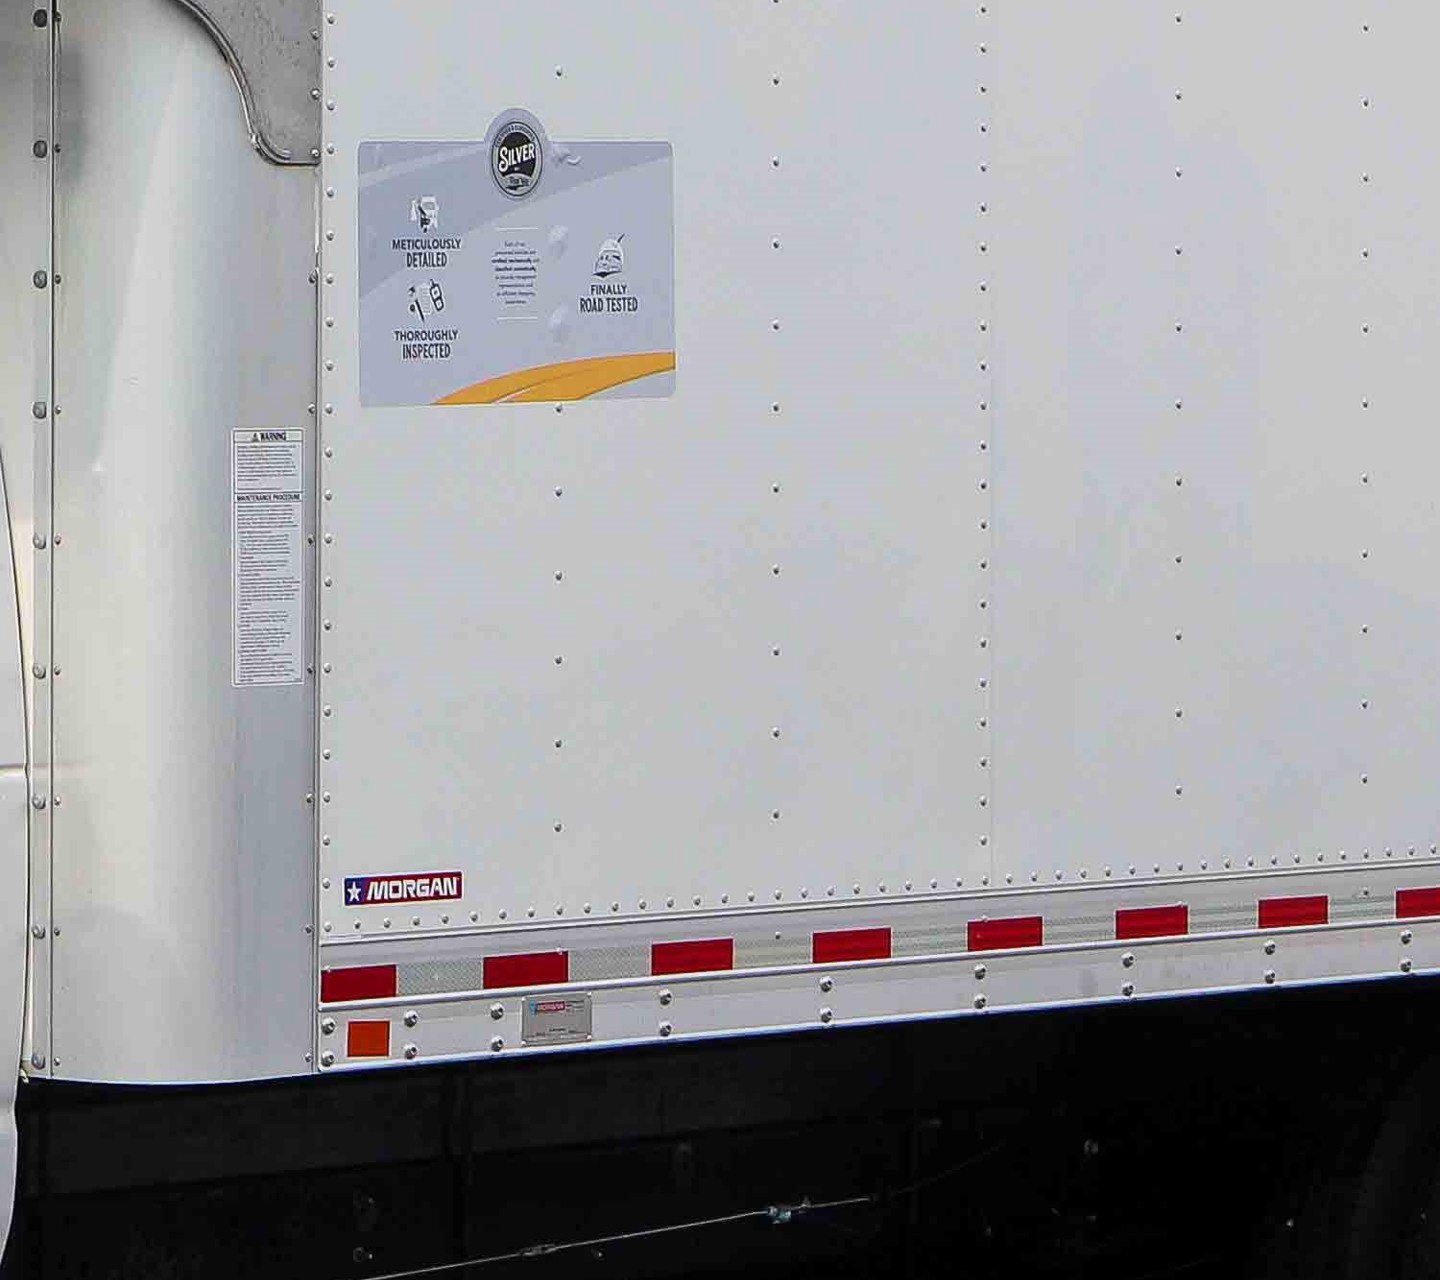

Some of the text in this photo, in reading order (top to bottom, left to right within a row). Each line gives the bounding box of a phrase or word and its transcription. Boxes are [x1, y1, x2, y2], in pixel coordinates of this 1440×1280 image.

[498, 143, 535, 172] SILVER
[392, 239, 461, 250] METICULOUSLY
[406, 252, 447, 267] DETAILED
[590, 284, 627, 295] FINALLY
[580, 297, 638, 312] ROAD TESTED
[394, 330, 458, 341] THOROUGHLY
[402, 343, 451, 359] INSPECTED
[366, 876, 458, 901] MORGAN
